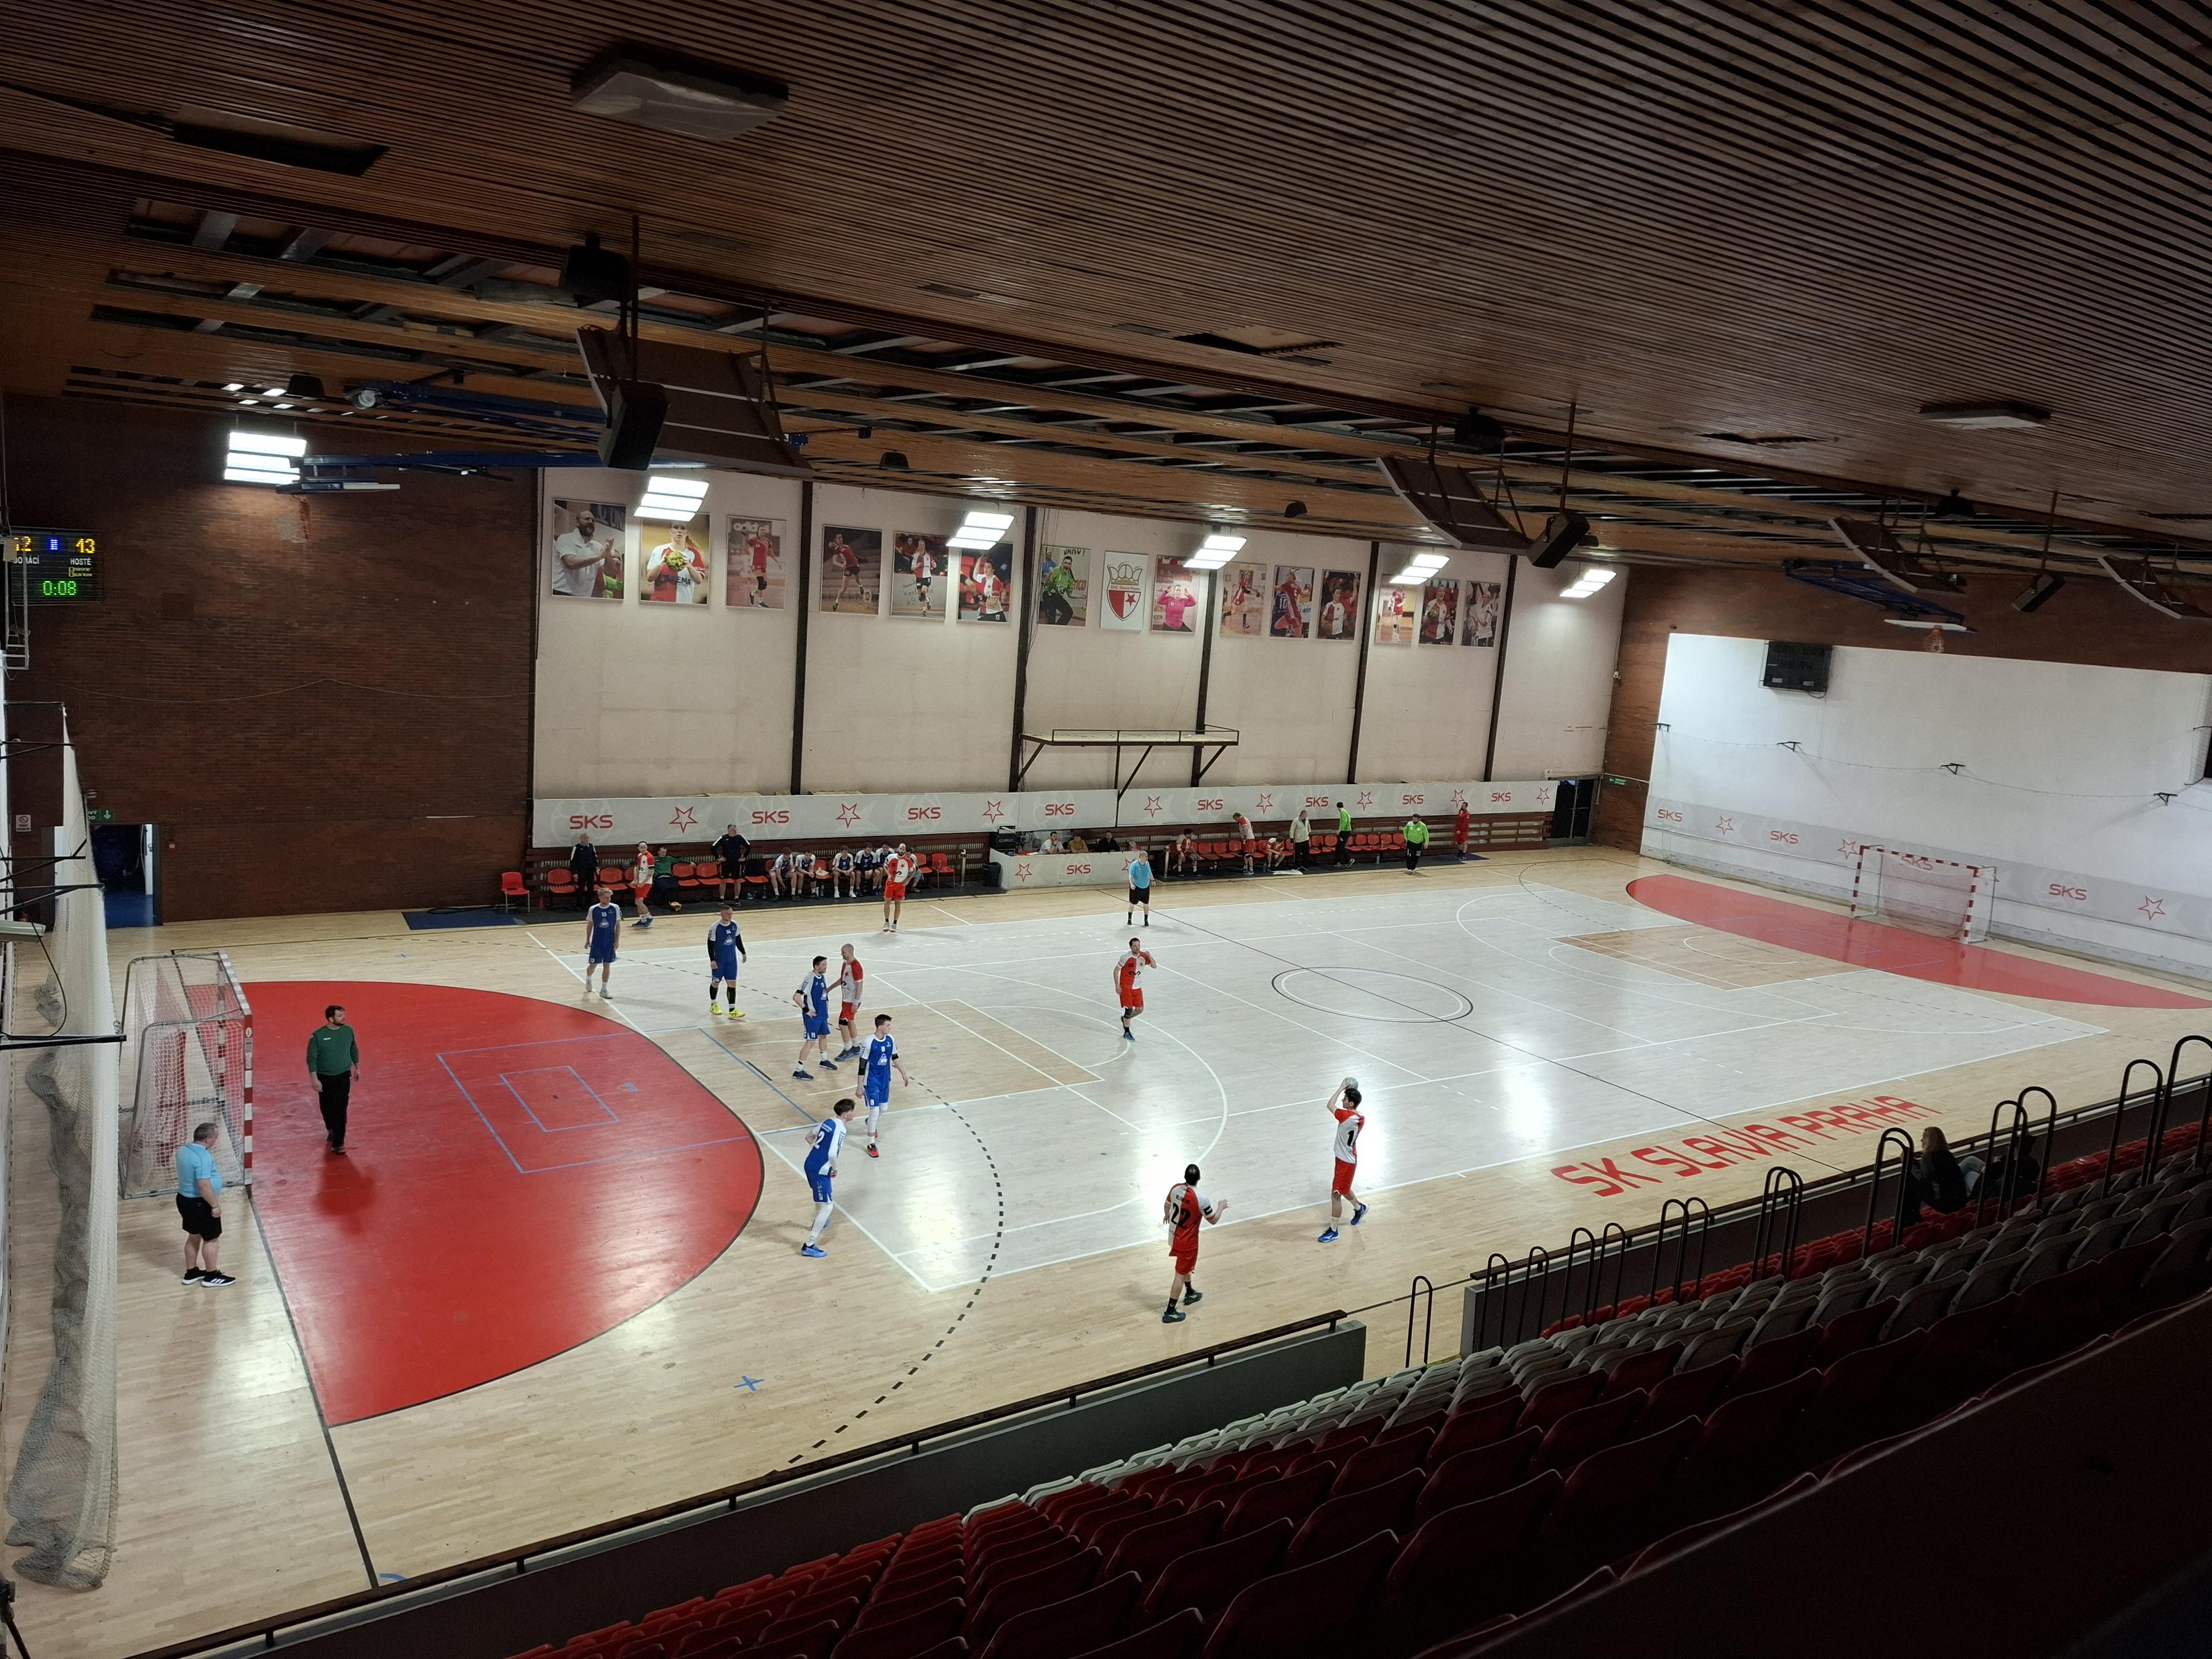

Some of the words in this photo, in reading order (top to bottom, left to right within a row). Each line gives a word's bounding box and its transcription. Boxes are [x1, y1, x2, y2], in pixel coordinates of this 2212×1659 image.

[76, 538, 96, 553] 13
[43, 581, 76, 595] 0:08
[1306, 796, 1329, 807] SKS
[1402, 794, 1424, 805] SKS
[1491, 792, 1511, 802] SKS
[1045, 804, 1074, 816] SKS
[1197, 799, 1223, 811] SKS
[752, 811, 790, 825] SKS
[907, 806, 941, 820] SKS
[1657, 808, 1683, 823] SKS
[570, 815, 613, 830] SKS
[1770, 830, 1800, 845] SKS
[1067, 864, 1092, 875] SKS
[2048, 883, 2088, 901] SKS
[1551, 1157, 1664, 1197] SK
[1630, 1124, 1818, 1177] SLAVIA
[1777, 1095, 1944, 1141] PRAHA
[1171, 1202, 1191, 1230] 22
